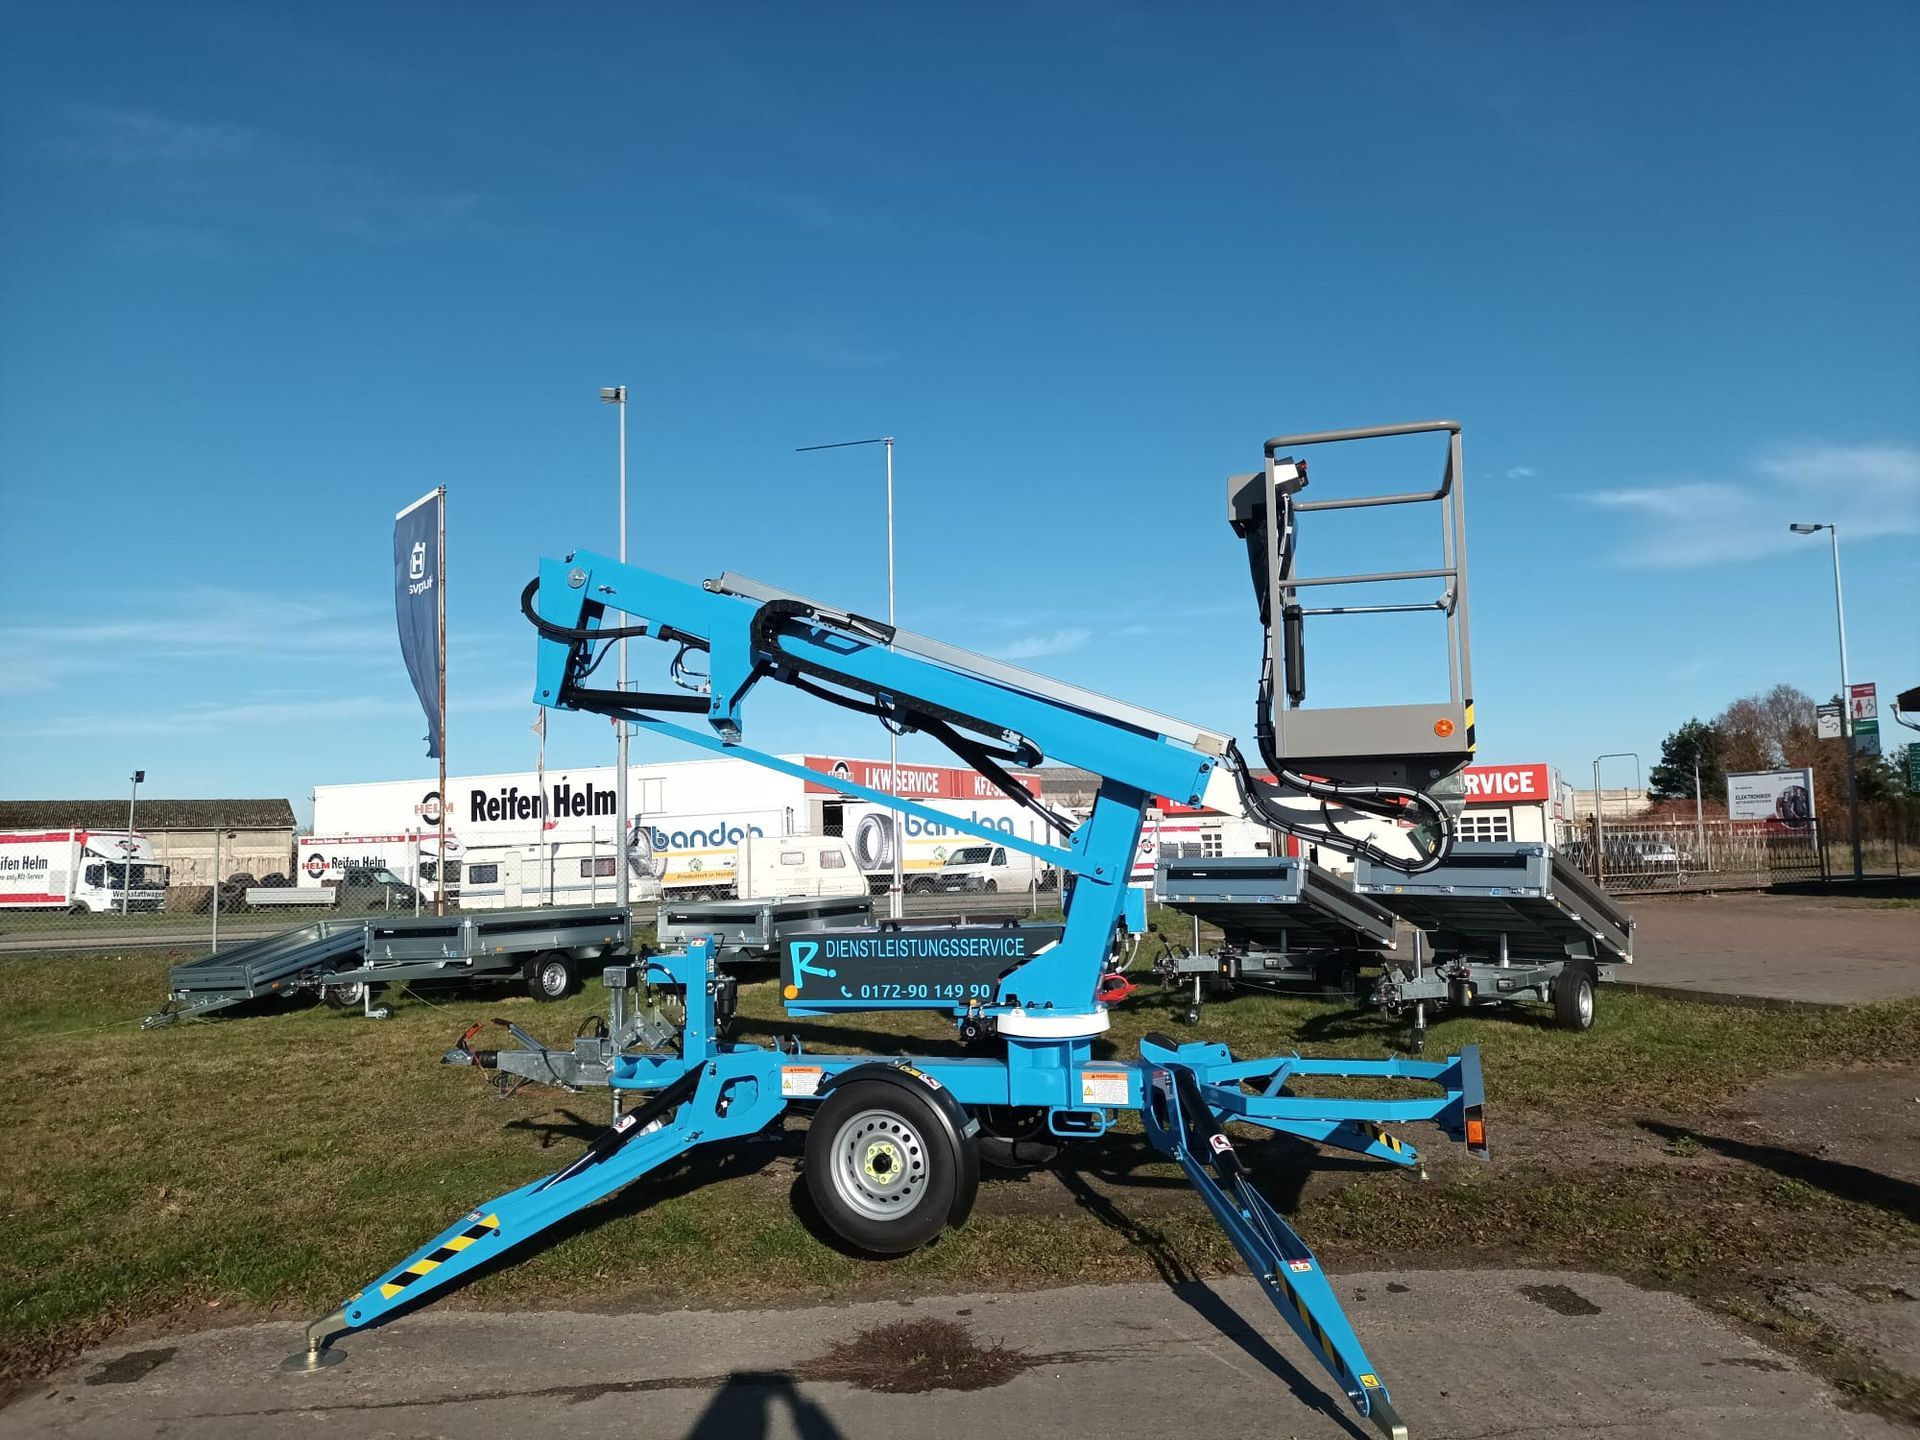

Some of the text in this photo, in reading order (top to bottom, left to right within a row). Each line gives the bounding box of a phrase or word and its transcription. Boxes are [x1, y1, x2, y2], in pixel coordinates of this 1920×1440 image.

[471, 783, 617, 823] Reifen Helm
[22, 855, 48, 870] Helm
[302, 862, 330, 870] HELM
[331, 855, 387, 869] Reifen Helm
[112, 890, 166, 899] Wekstattwagen
[825, 937, 1025, 959] DIENSTLEISTUNGSSERVICE
[860, 984, 990, 998] 0172-90 149 90
